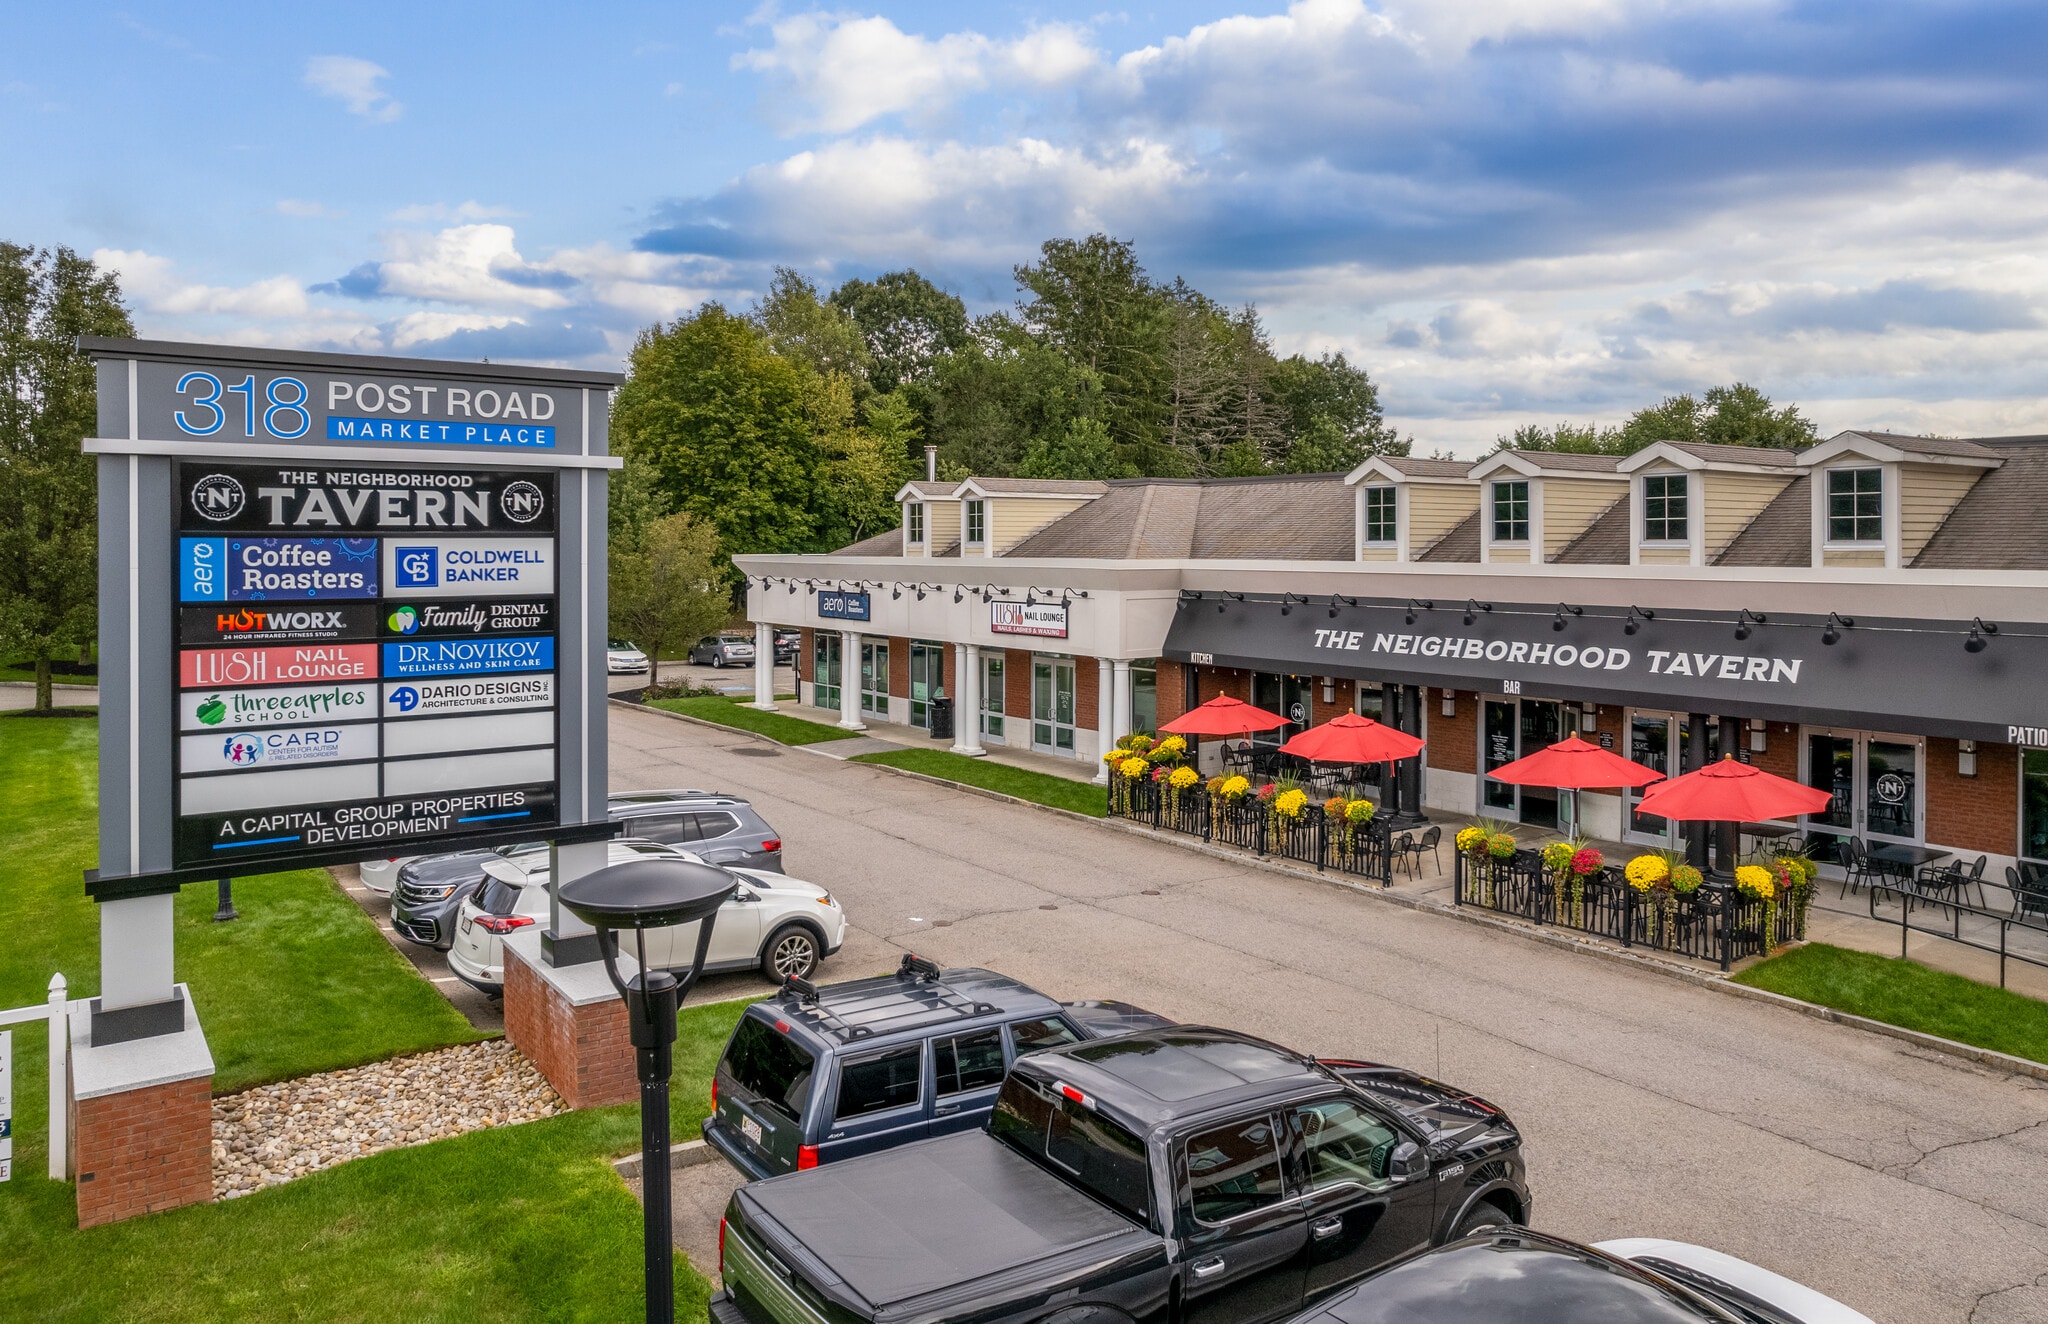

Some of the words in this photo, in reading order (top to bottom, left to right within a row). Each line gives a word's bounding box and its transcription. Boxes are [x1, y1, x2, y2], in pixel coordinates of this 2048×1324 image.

[174, 371, 312, 440] 318
[328, 381, 438, 415] POST
[447, 388, 555, 420] ROAD
[338, 421, 450, 440] MARKET
[466, 426, 546, 444] PLACE
[279, 471, 318, 485] THE
[326, 472, 473, 488] NEIGHBORHOOD
[258, 487, 491, 527] TAVERN
[242, 544, 332, 567] Coffee
[446, 550, 544, 564] COLDWELL
[193, 542, 214, 595] aero
[446, 568, 519, 582] BANKER
[242, 568, 364, 590] Roasters
[491, 604, 548, 616] DENTAL
[823, 597, 844, 612] aero
[420, 604, 488, 632] Family
[491, 616, 541, 628] GROUP
[996, 604, 1017, 624] LUSH
[1024, 612, 1039, 621] NAIL
[1040, 612, 1064, 623] LOUNGE
[296, 648, 349, 662] NAIL
[439, 642, 540, 660] NOVIKOV
[1191, 652, 1213, 664] KITCHEN
[1314, 629, 1364, 650] THE
[1372, 632, 1631, 670] NEIGHBORHOOD
[1647, 650, 1803, 684] TAVERN
[196, 651, 266, 684] LUSH
[276, 662, 365, 678] LOUNGE
[399, 663, 455, 672] WELLNESS
[458, 662, 482, 670] AND
[485, 660, 510, 668] SKIN
[422, 684, 471, 699] DARIO
[474, 680, 541, 696] DESIGNS
[1503, 680, 1520, 695] BAR
[422, 698, 488, 708] ARCHITECTURE
[497, 694, 549, 704] CONSULTING
[234, 710, 309, 722] SCHOOL
[267, 730, 339, 747] CARD
[2008, 725, 2048, 746] PATIO
[268, 747, 296, 755] CENTER
[220, 820, 236, 836] A
[241, 811, 327, 834] CAPITAL
[334, 804, 404, 824] GROUP
[411, 791, 525, 816] PROPERTIES
[307, 815, 451, 844] DEVELOPMENT
